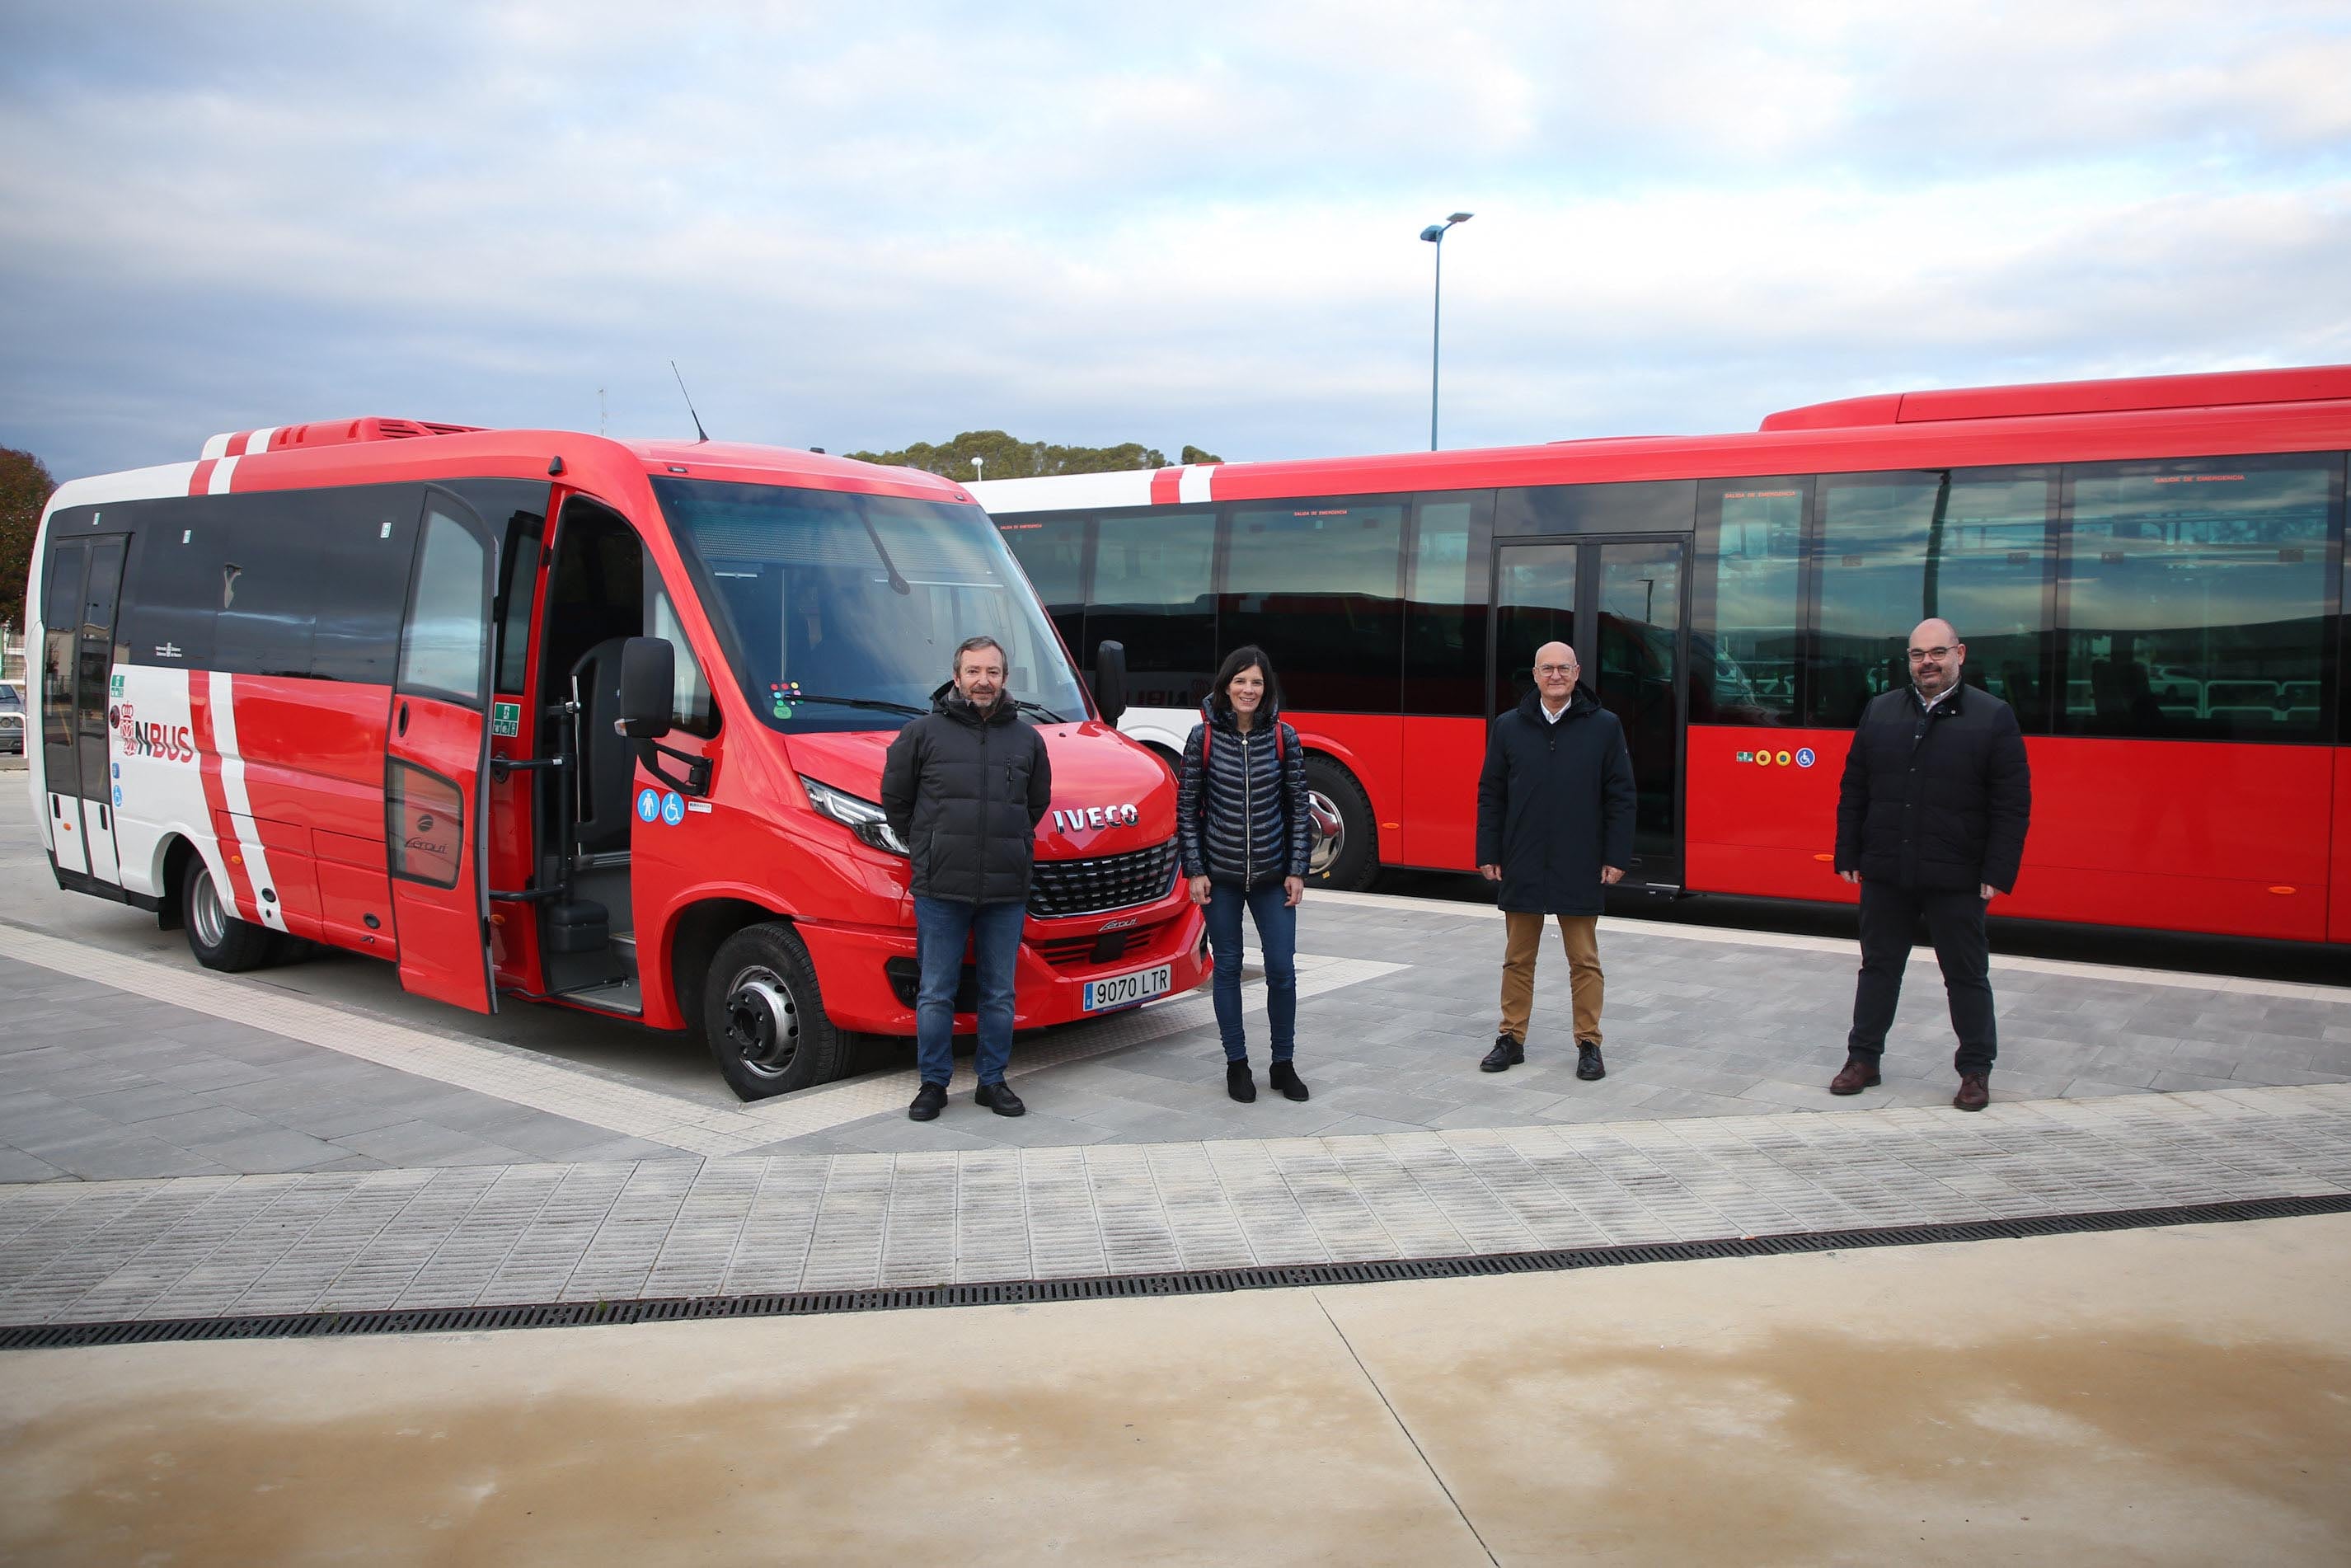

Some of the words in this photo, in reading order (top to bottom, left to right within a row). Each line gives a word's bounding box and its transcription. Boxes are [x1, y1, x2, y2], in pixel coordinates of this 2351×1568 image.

[135, 721, 194, 763] NBUS
[1053, 804, 1138, 834] IVECO
[1097, 978, 1137, 1004] 9070
[1143, 969, 1167, 994] LTR
